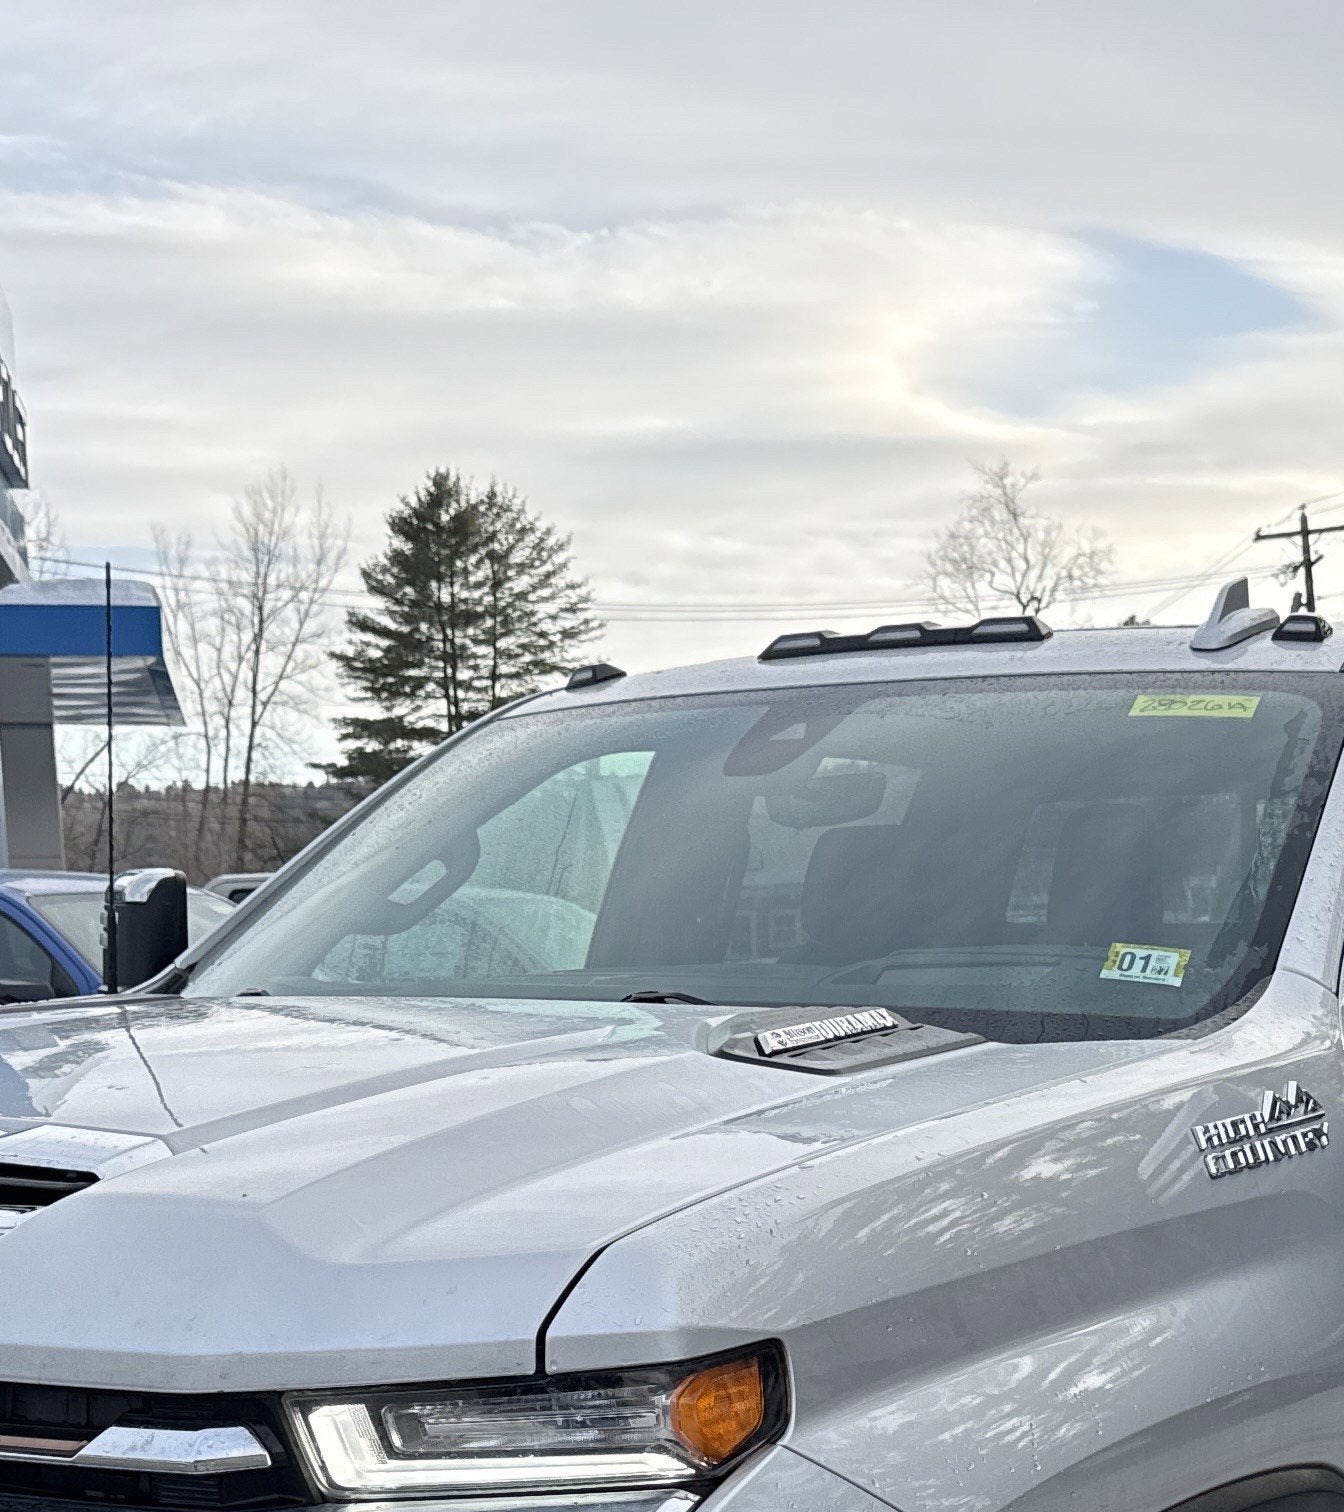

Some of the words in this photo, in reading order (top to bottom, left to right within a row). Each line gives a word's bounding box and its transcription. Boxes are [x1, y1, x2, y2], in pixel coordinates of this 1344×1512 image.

[1116, 951, 1153, 974] 01
[812, 1008, 899, 1040] DURAMAX
[1191, 1111, 1268, 1150] HIGH
[1204, 1121, 1329, 1180] COUNTRY
